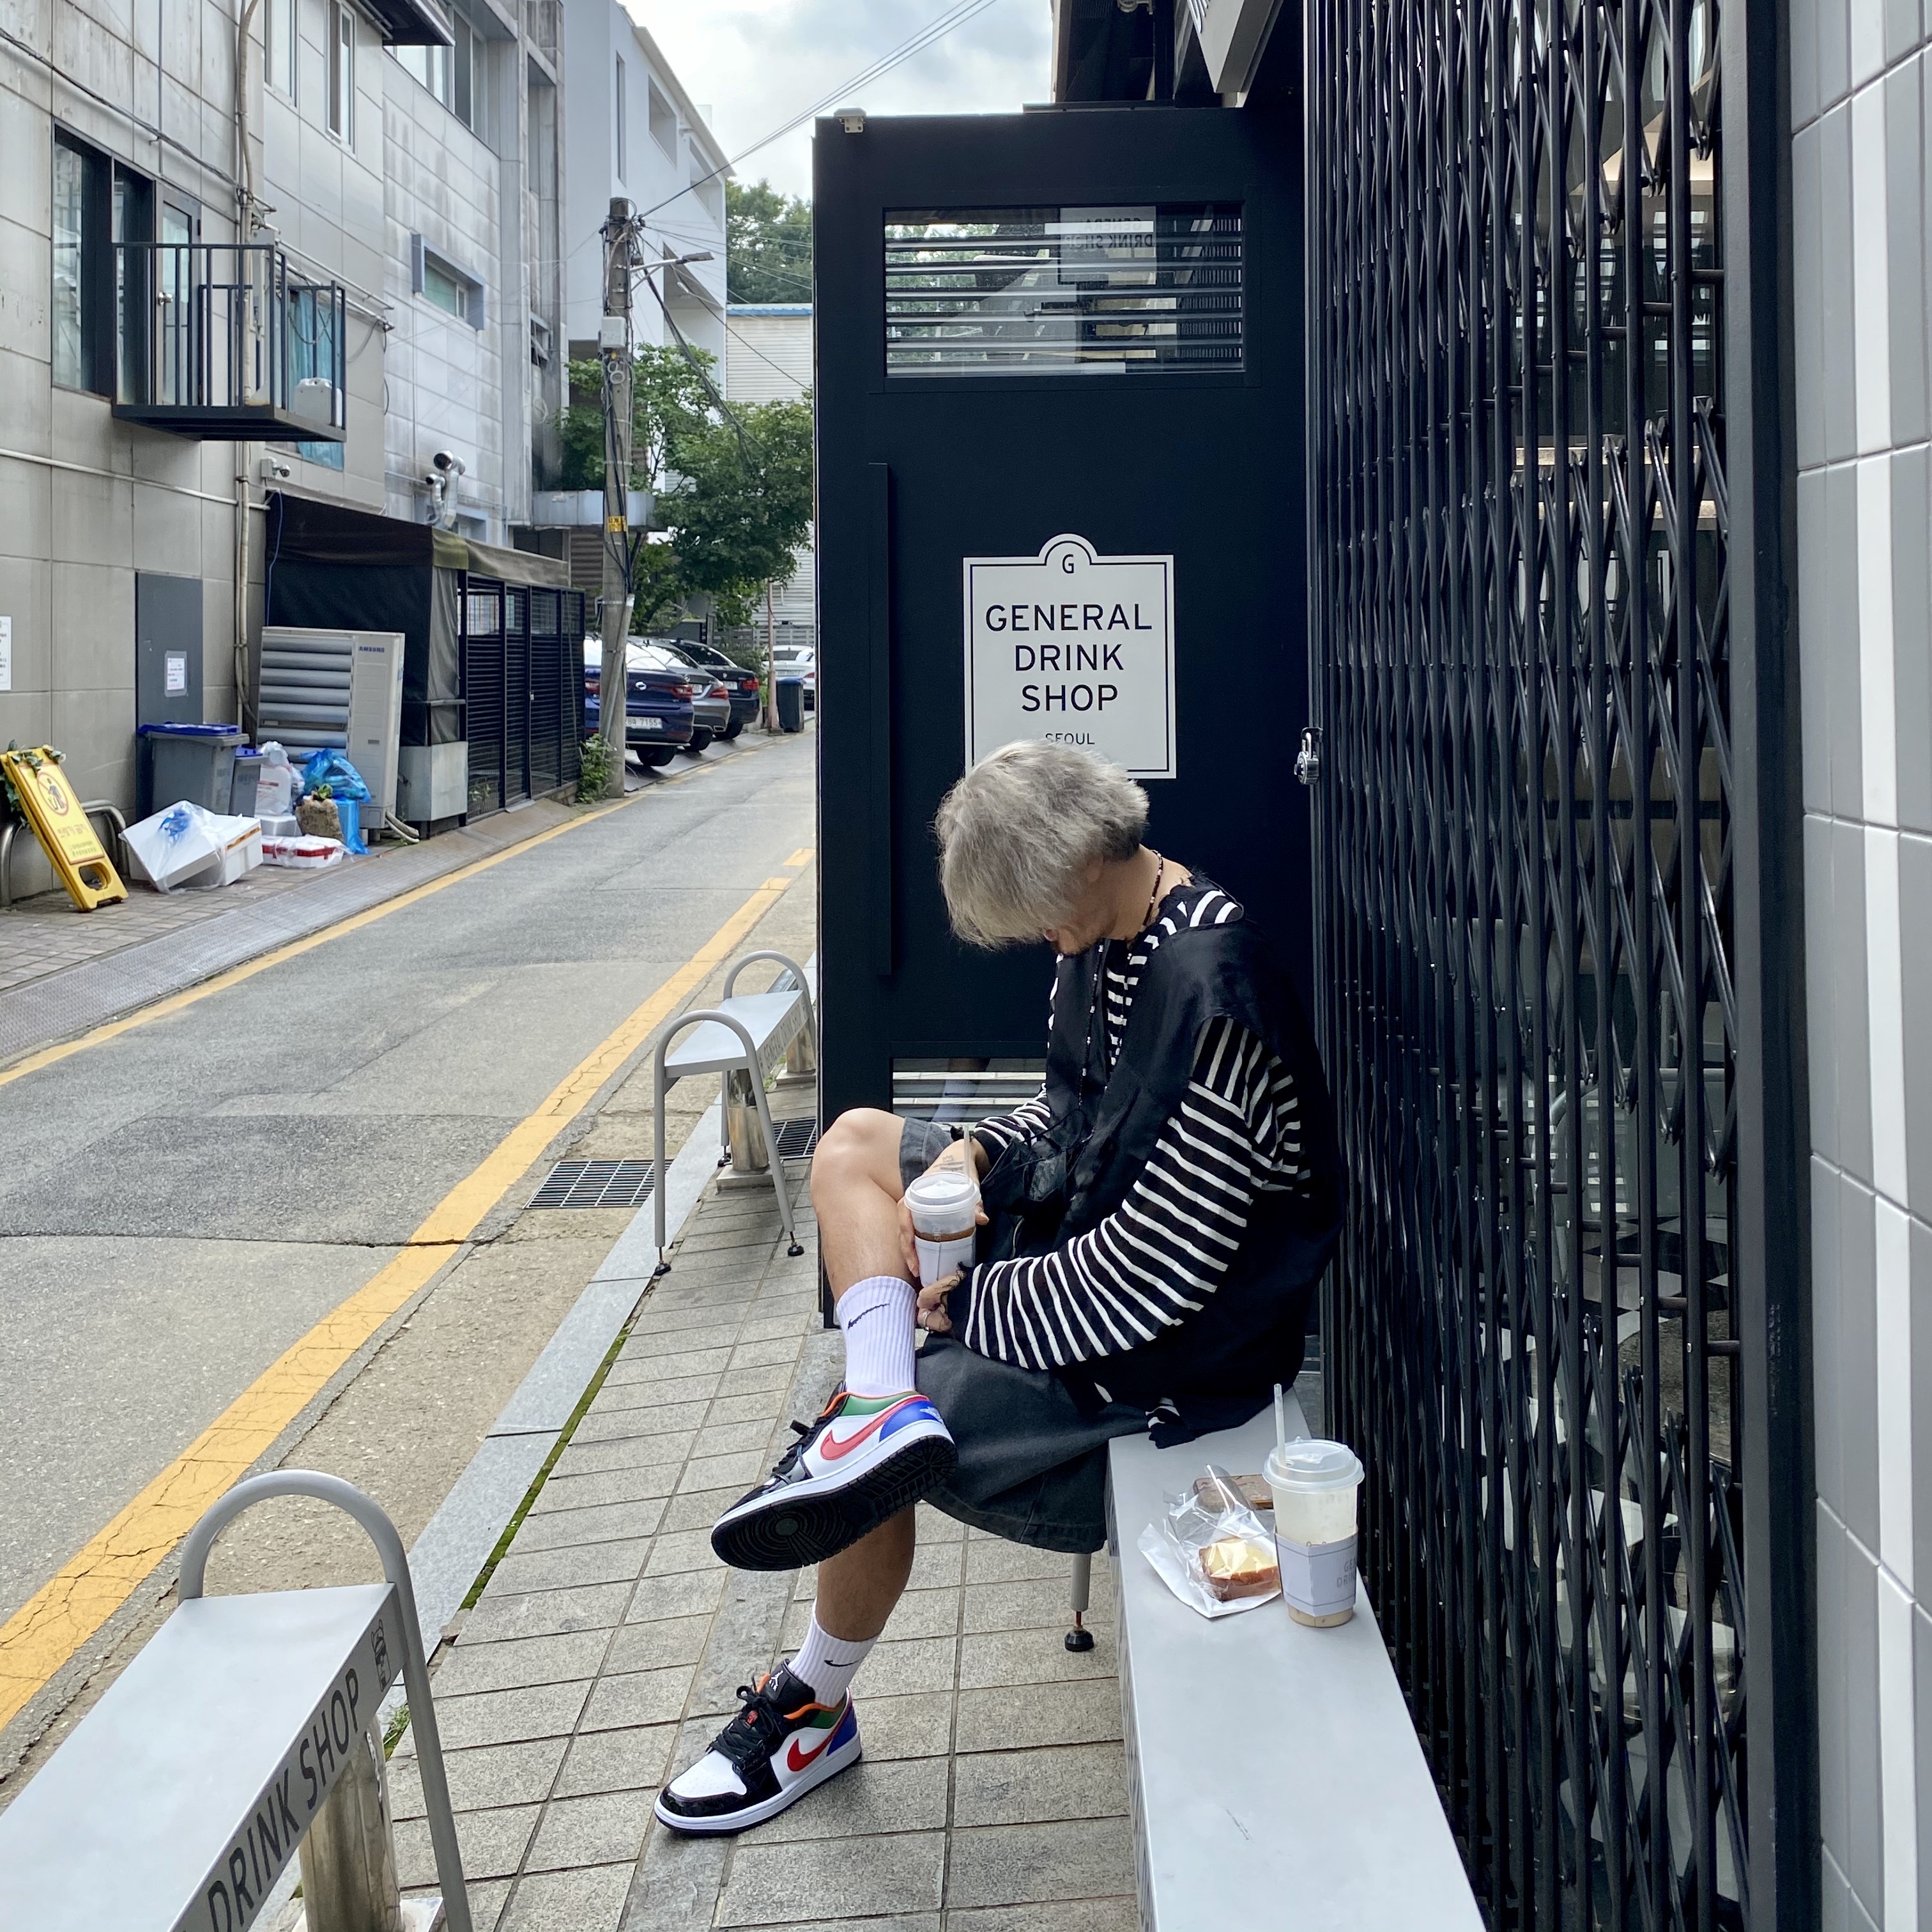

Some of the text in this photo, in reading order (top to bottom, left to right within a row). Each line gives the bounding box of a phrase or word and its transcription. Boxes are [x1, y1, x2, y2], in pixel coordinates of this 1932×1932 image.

[1062, 554, 1075, 574] G
[985, 603, 1153, 631] GENERAL
[1015, 644, 1124, 671] DRINK
[1022, 684, 1118, 712] SHOP
[207, 1668, 360, 1932] DRINK SHOP
